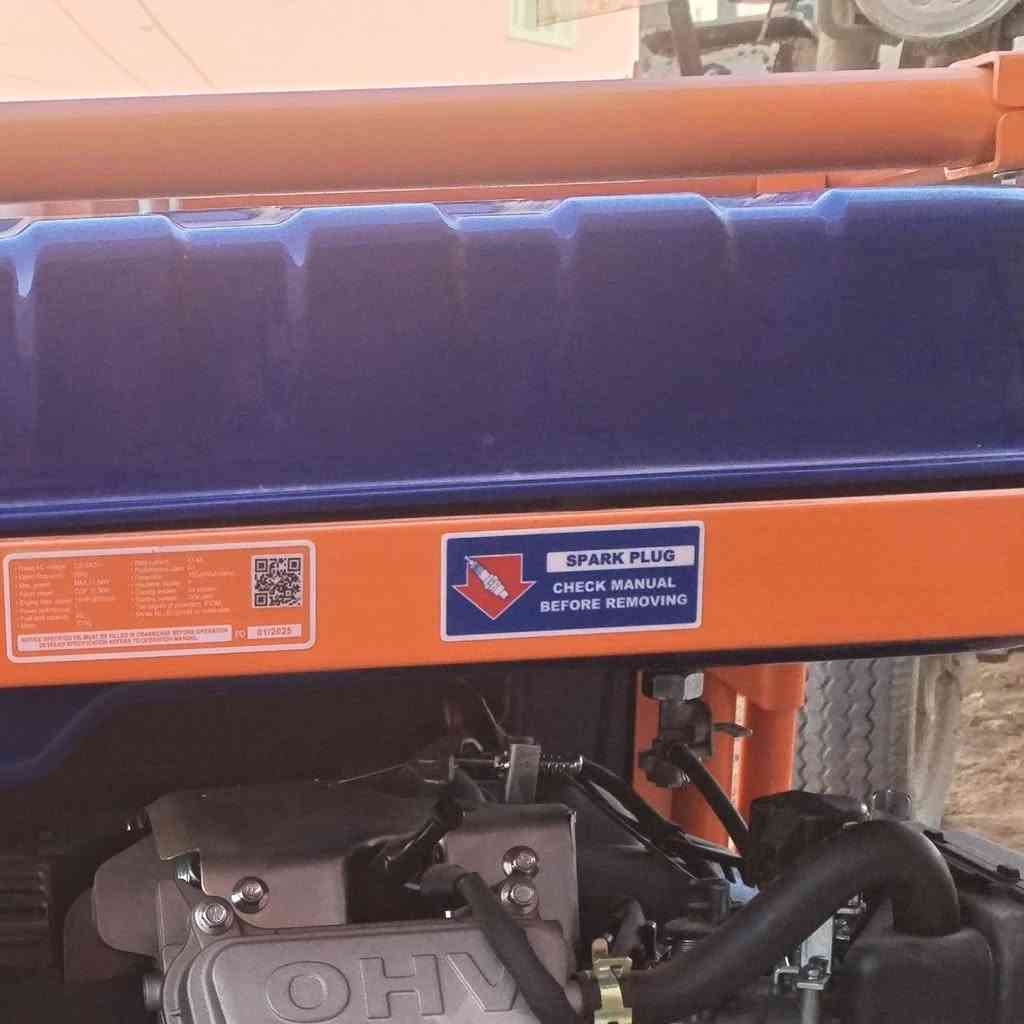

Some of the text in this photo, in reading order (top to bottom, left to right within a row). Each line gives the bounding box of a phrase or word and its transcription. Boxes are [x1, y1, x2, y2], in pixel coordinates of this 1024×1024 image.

[566, 550, 676, 567] SPARK PLUG
[552, 576, 676, 594] CHECK MANUAL
[540, 594, 688, 612] BEFORE REMOVING
[265, 951, 521, 1024] OHV
